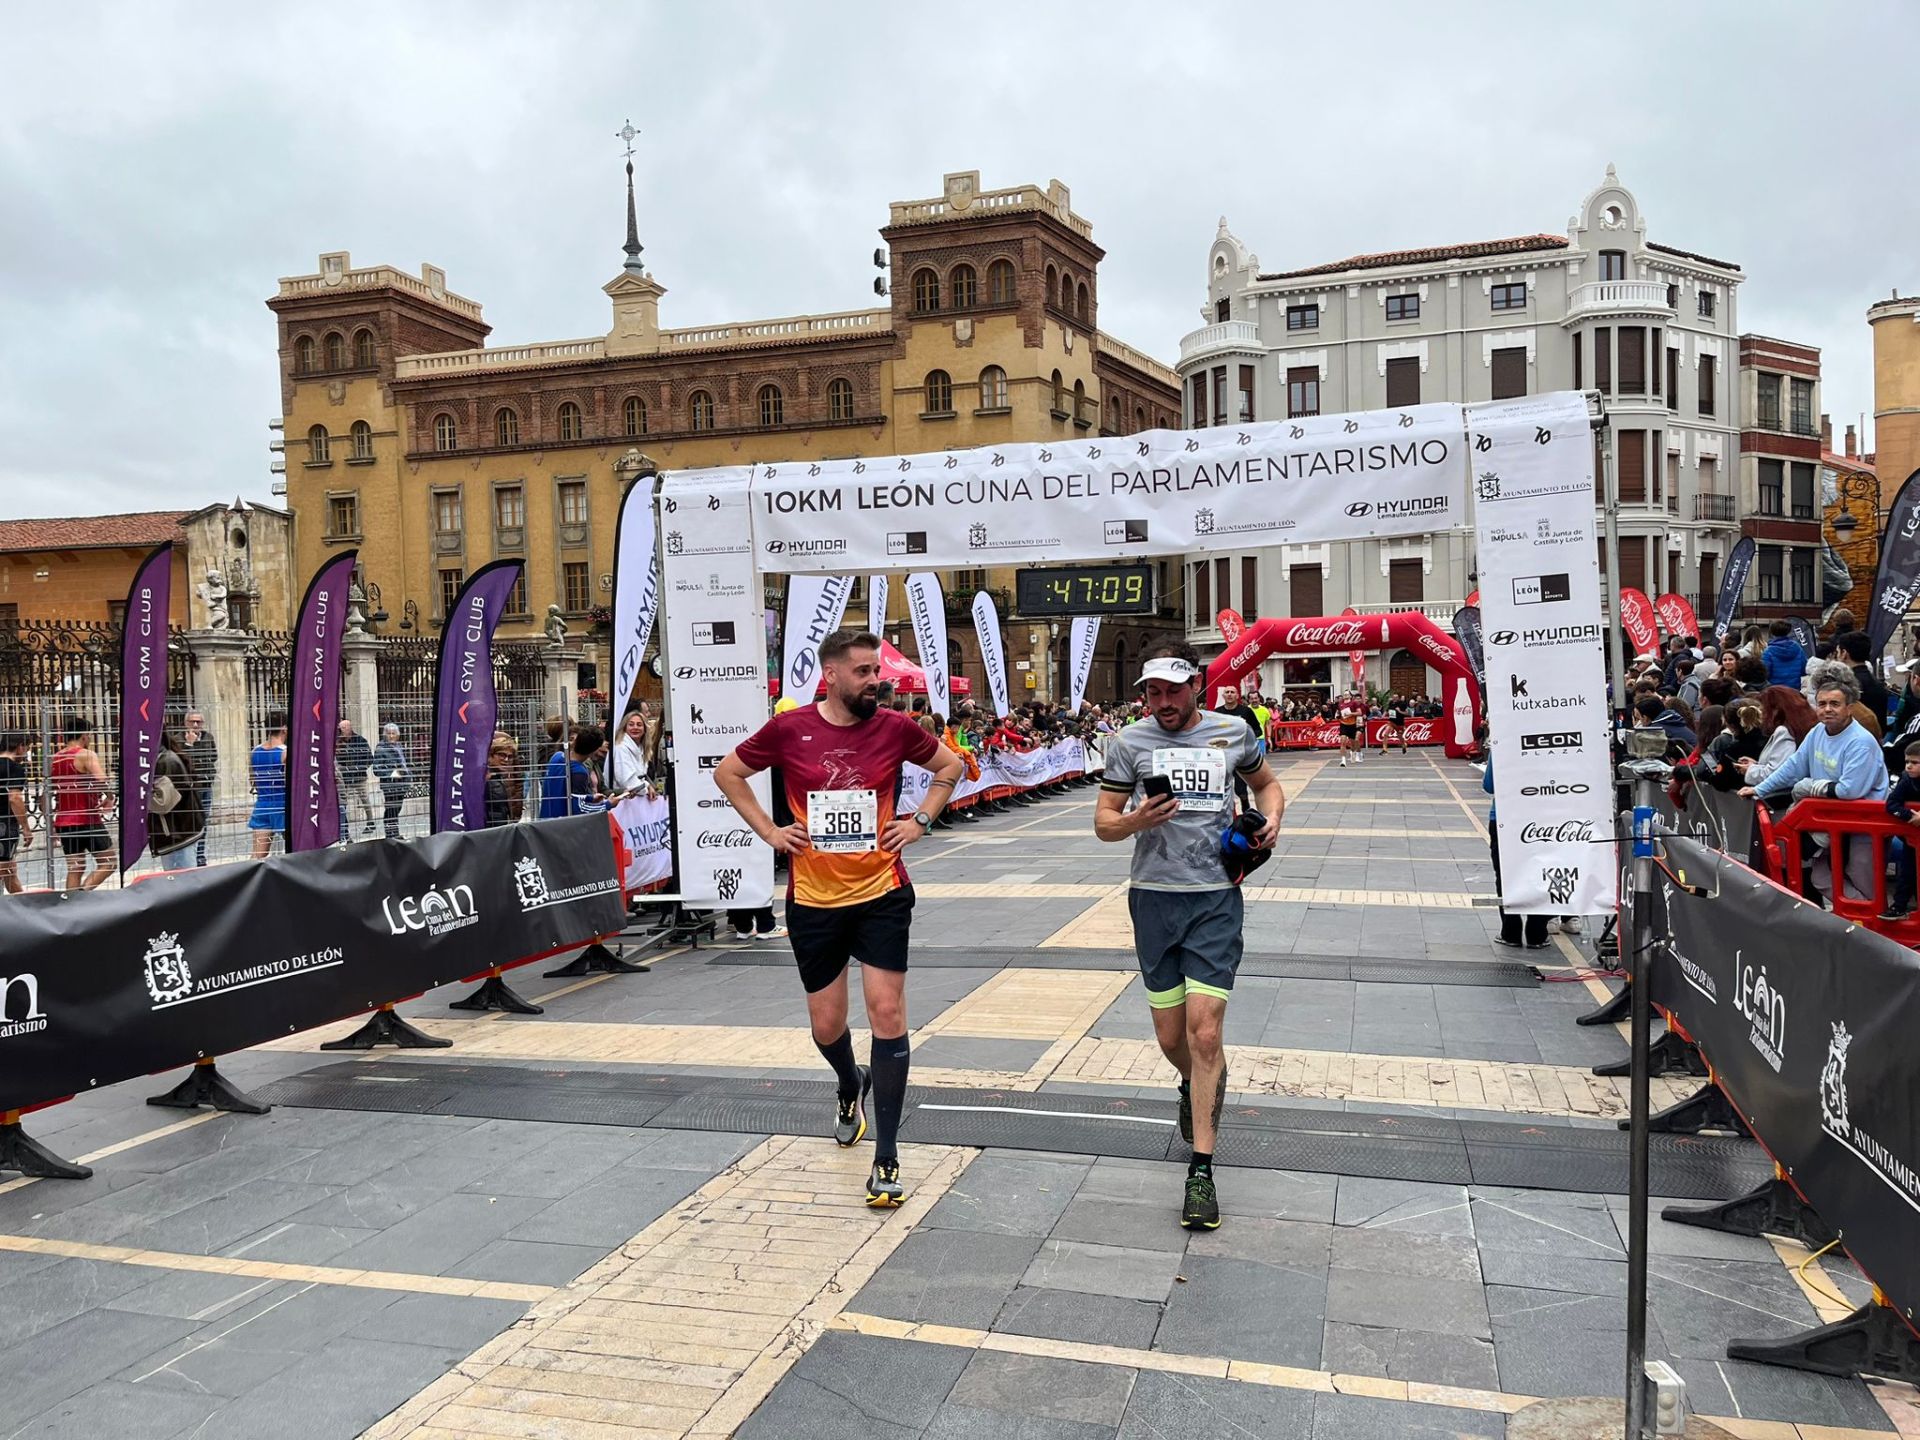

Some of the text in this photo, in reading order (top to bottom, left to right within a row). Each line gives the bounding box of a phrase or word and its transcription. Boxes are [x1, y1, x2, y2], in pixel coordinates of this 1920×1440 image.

[764, 440, 1448, 514] 10KM LEÓN CUNA DEL PARLAMENTARISMO
[1502, 486, 1559, 497] AYUNTAMIENTO
[1377, 496, 1448, 514] HYUNDAI
[1377, 508, 1449, 520] Lemauto Automoción
[1215, 522, 1266, 532] AYUNTAMIENTO
[1552, 530, 1572, 538] Junta
[788, 539, 847, 552] HYUNDAI
[988, 538, 1034, 547] AYUNTAMIENTO
[1491, 532, 1529, 543] IMPULSA
[1534, 538, 1559, 546] Castilla
[1516, 584, 1539, 595] LEÓN
[1286, 620, 1368, 646] Coca-Cola
[1523, 625, 1600, 642] HYUNDAI
[1079, 617, 1097, 671] HYUNDA
[1418, 634, 1456, 662] Coca-Cola
[1523, 636, 1601, 648] Lemauto Automoción
[1230, 638, 1261, 671] Coca-Cola
[699, 665, 758, 677] HYUNDAI
[139, 587, 152, 823] TAFIT GYM CLUB
[310, 590, 329, 827] ALTAFIT GYM CLUB
[1512, 694, 1587, 711] kutxabank
[451, 596, 485, 832] ALTAFIT GYM CLUB
[691, 723, 749, 735] kutxabank
[1521, 748, 1584, 757] PLAZA
[1172, 769, 1209, 792] 599
[1520, 780, 1590, 796] emico
[825, 812, 862, 834] 368
[696, 828, 754, 849] Coca-Cola
[1520, 820, 1595, 844] Coca-Cola
[597, 881, 606, 890] DE
[607, 877, 620, 889] LEÓN
[442, 910, 454, 922] del
[428, 914, 479, 937] Parlamentarismo
[196, 946, 343, 993] AYUNTAMIENTO DE LEÓN
[1854, 1127, 1920, 1197] AYUNTAMIEN
